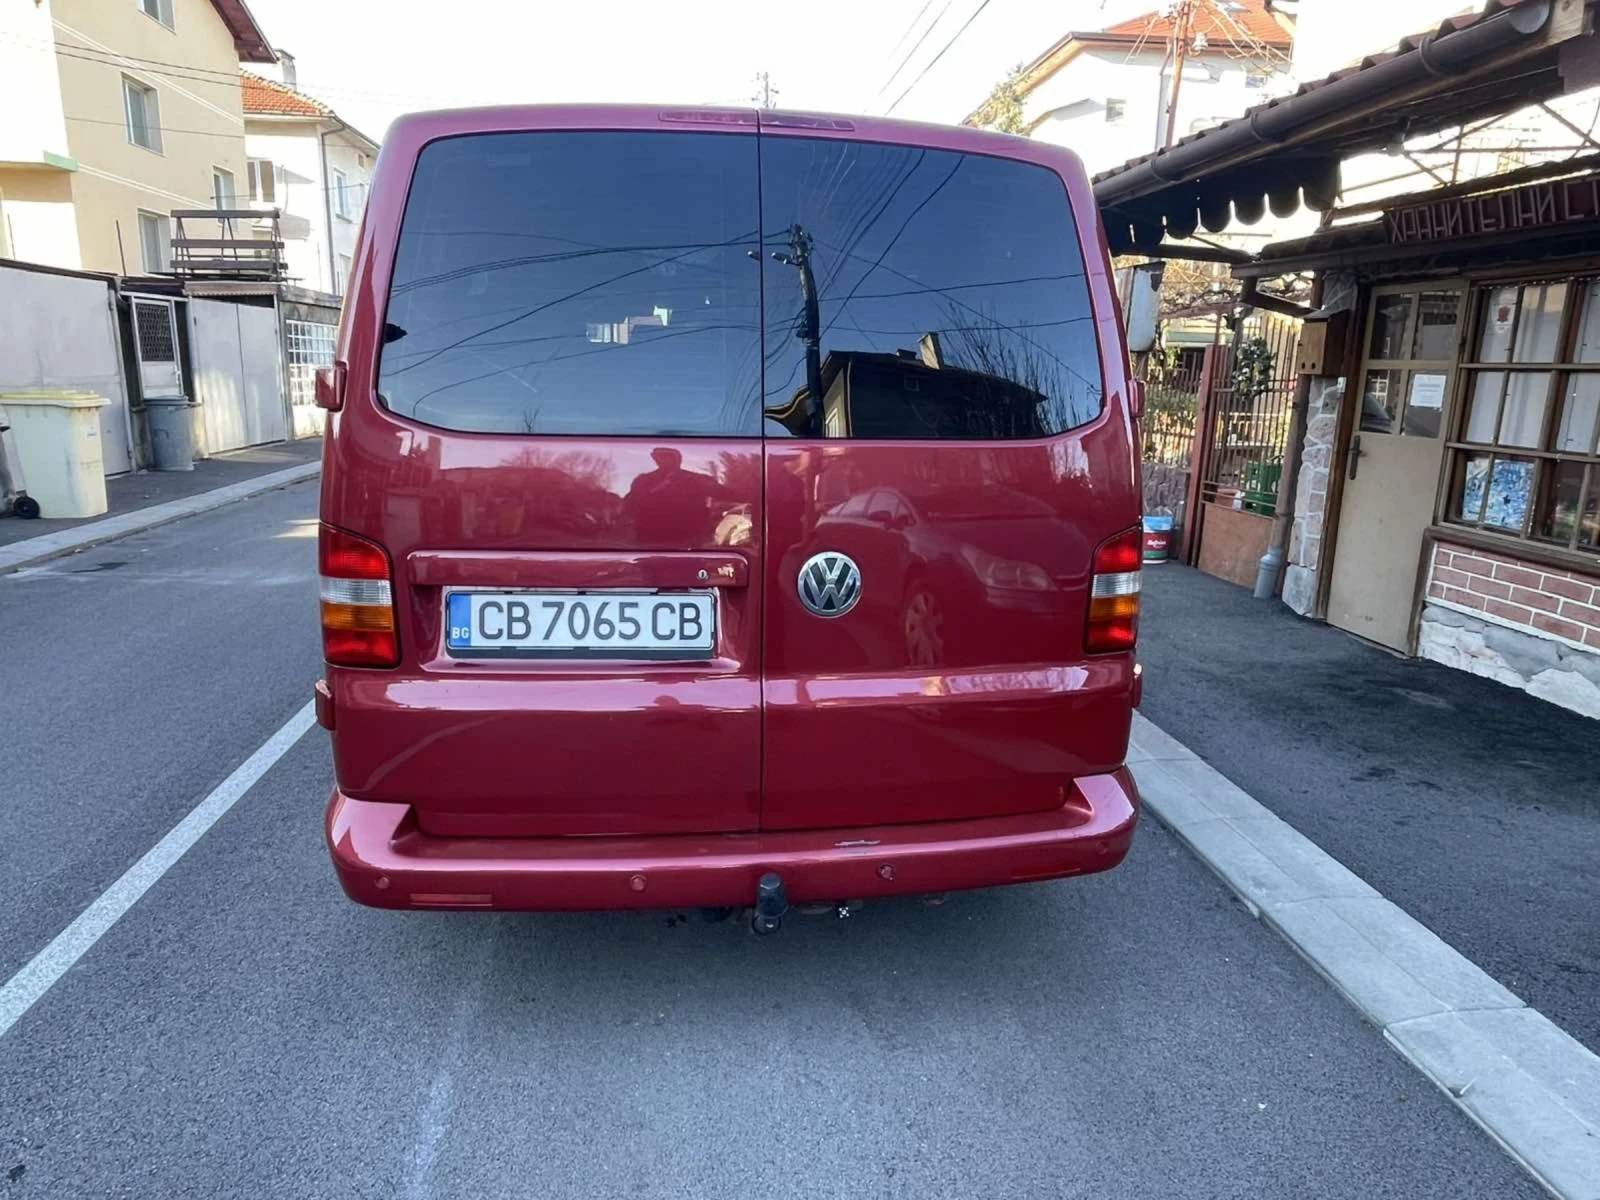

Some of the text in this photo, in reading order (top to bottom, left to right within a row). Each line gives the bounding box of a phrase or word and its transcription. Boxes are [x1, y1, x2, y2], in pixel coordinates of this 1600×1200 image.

[452, 627, 469, 639] BG
[479, 601, 703, 641] CB 7065 CB
